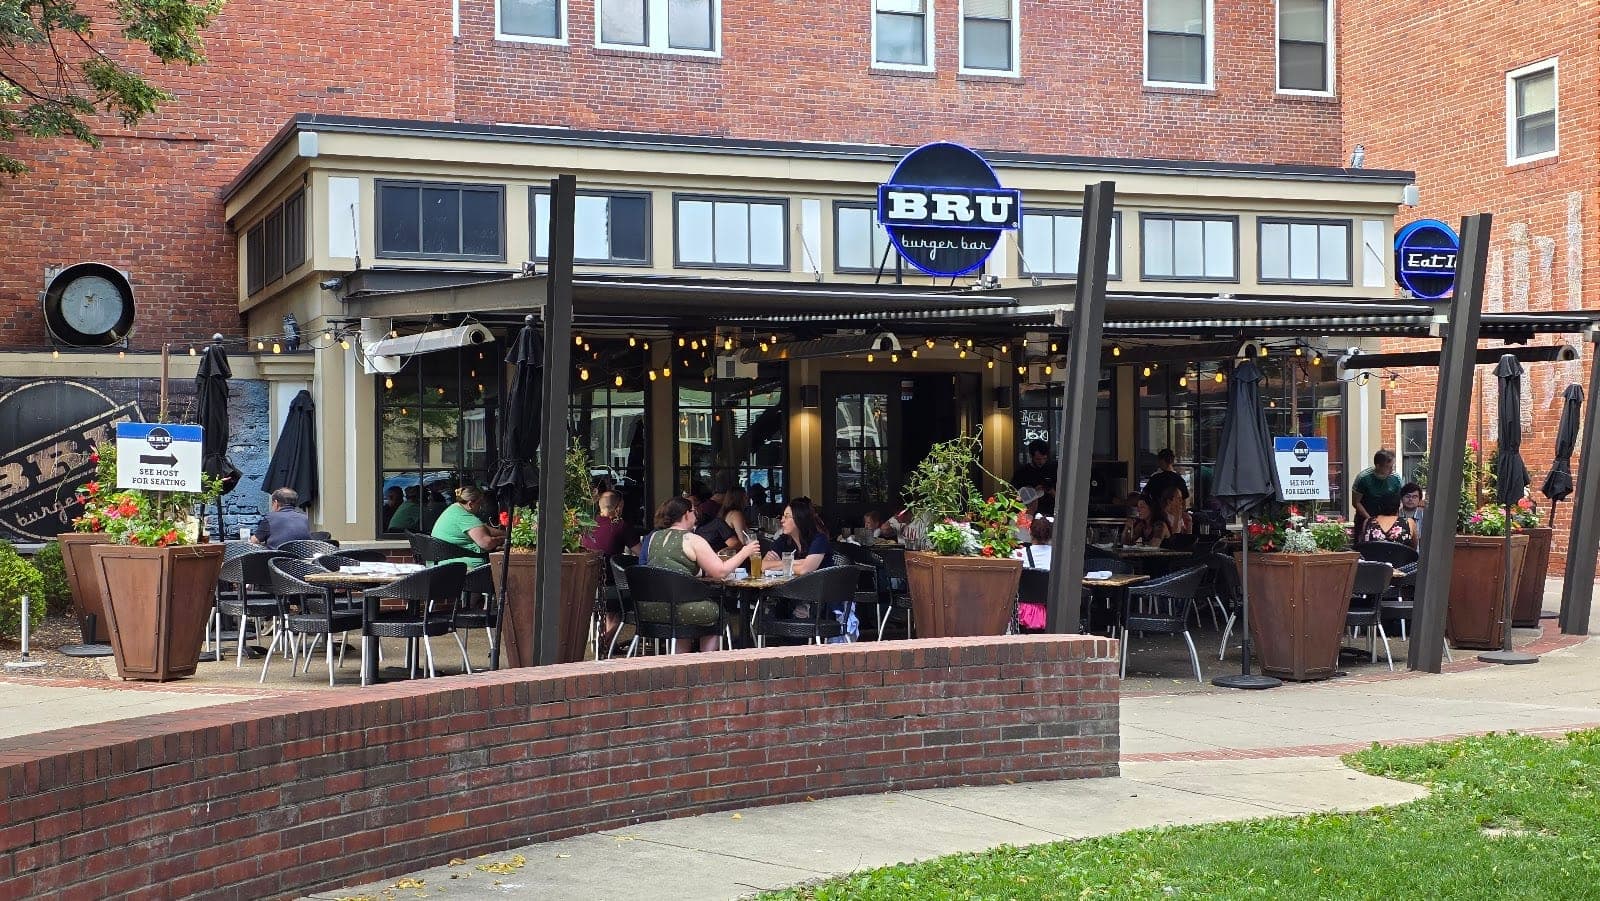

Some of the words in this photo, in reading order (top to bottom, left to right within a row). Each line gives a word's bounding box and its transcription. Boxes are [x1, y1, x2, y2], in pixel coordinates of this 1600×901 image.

[888, 191, 1013, 223] BRU
[902, 234, 958, 260] burger
[961, 237, 991, 250] bar
[1407, 253, 1446, 268] Eat
[132, 477, 149, 485] FOR
[150, 478, 186, 487] SEATING
[139, 468, 154, 476] SEE
[156, 469, 179, 477] HOST
[16, 496, 84, 525] burge
